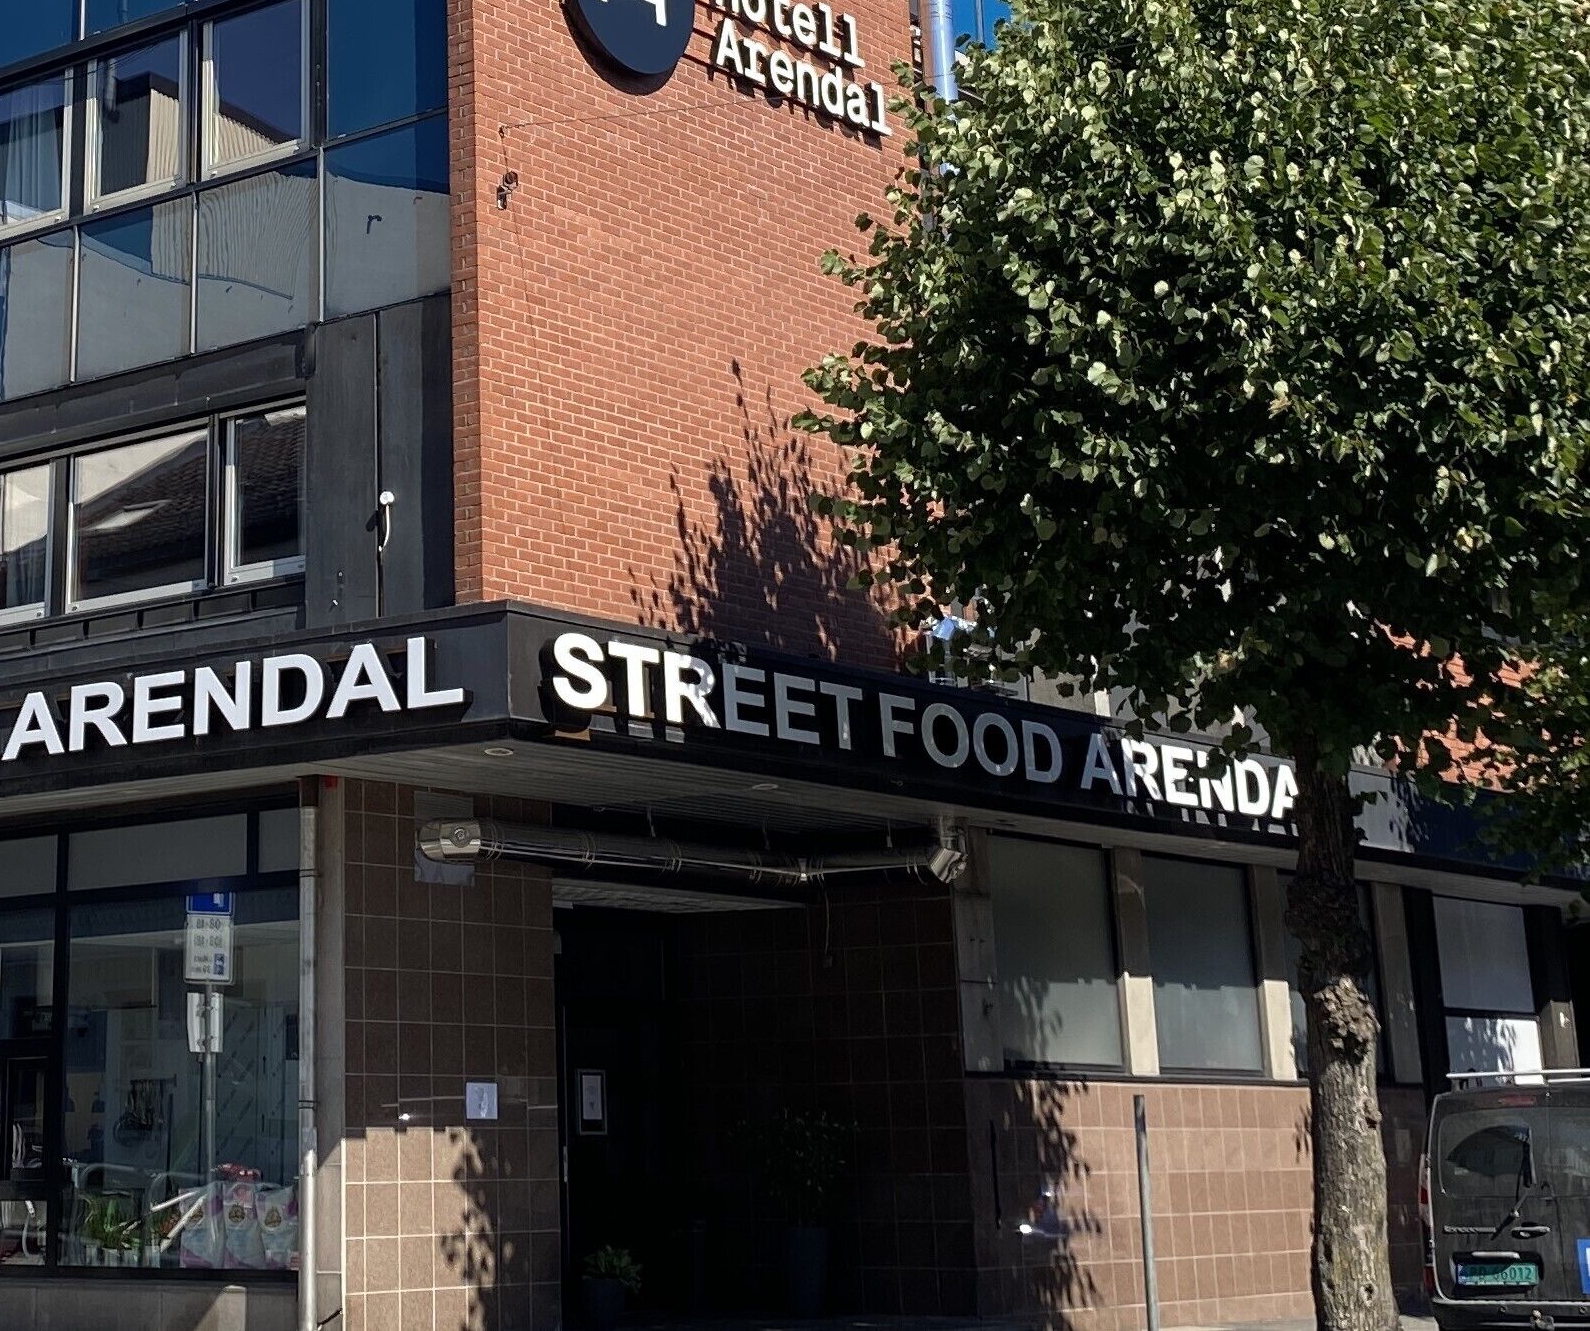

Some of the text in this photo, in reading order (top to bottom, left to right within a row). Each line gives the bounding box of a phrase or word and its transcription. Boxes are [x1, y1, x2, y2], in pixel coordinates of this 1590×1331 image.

[716, 17, 893, 136] Arendal
[1, 636, 464, 761] ARENDAL
[552, 632, 1299, 820] STREET FOOD ARENDA
